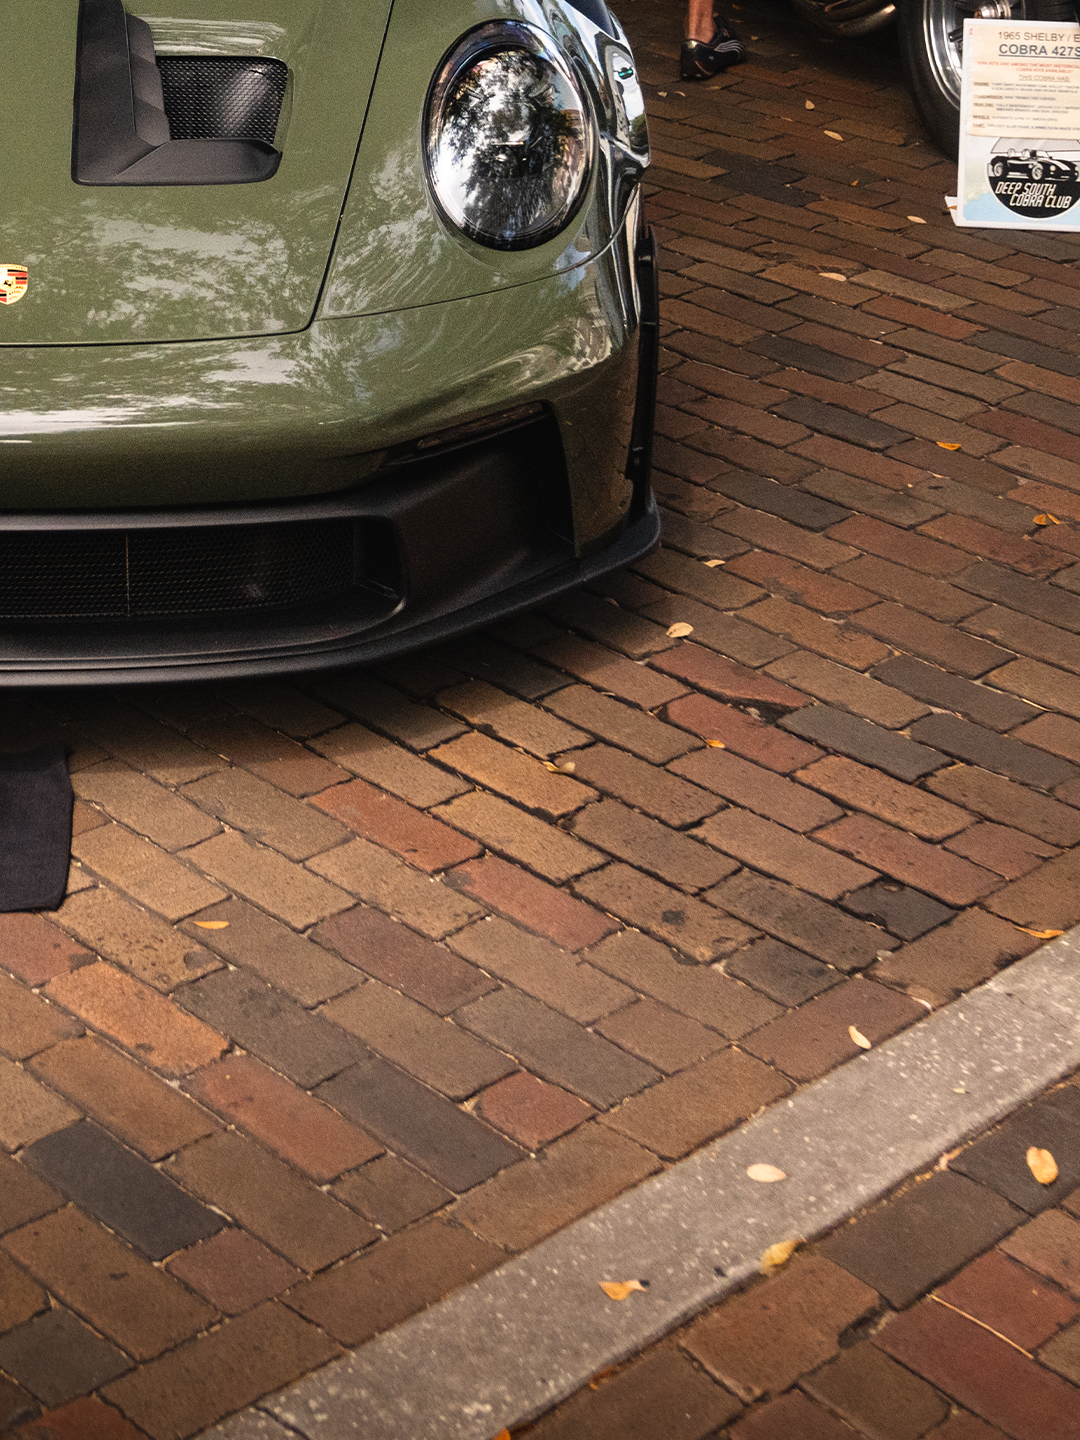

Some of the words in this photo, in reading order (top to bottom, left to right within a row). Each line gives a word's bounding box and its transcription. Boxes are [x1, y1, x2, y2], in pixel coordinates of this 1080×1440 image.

[998, 32, 1021, 40] 1965
[1024, 33, 1064, 41] SHELBY
[999, 44, 1047, 55] COBRA
[995, 181, 1022, 194] DEEP
[1022, 183, 1056, 196] SOUTH
[1009, 194, 1044, 207] COBRA
[1045, 196, 1072, 209] CLUB
